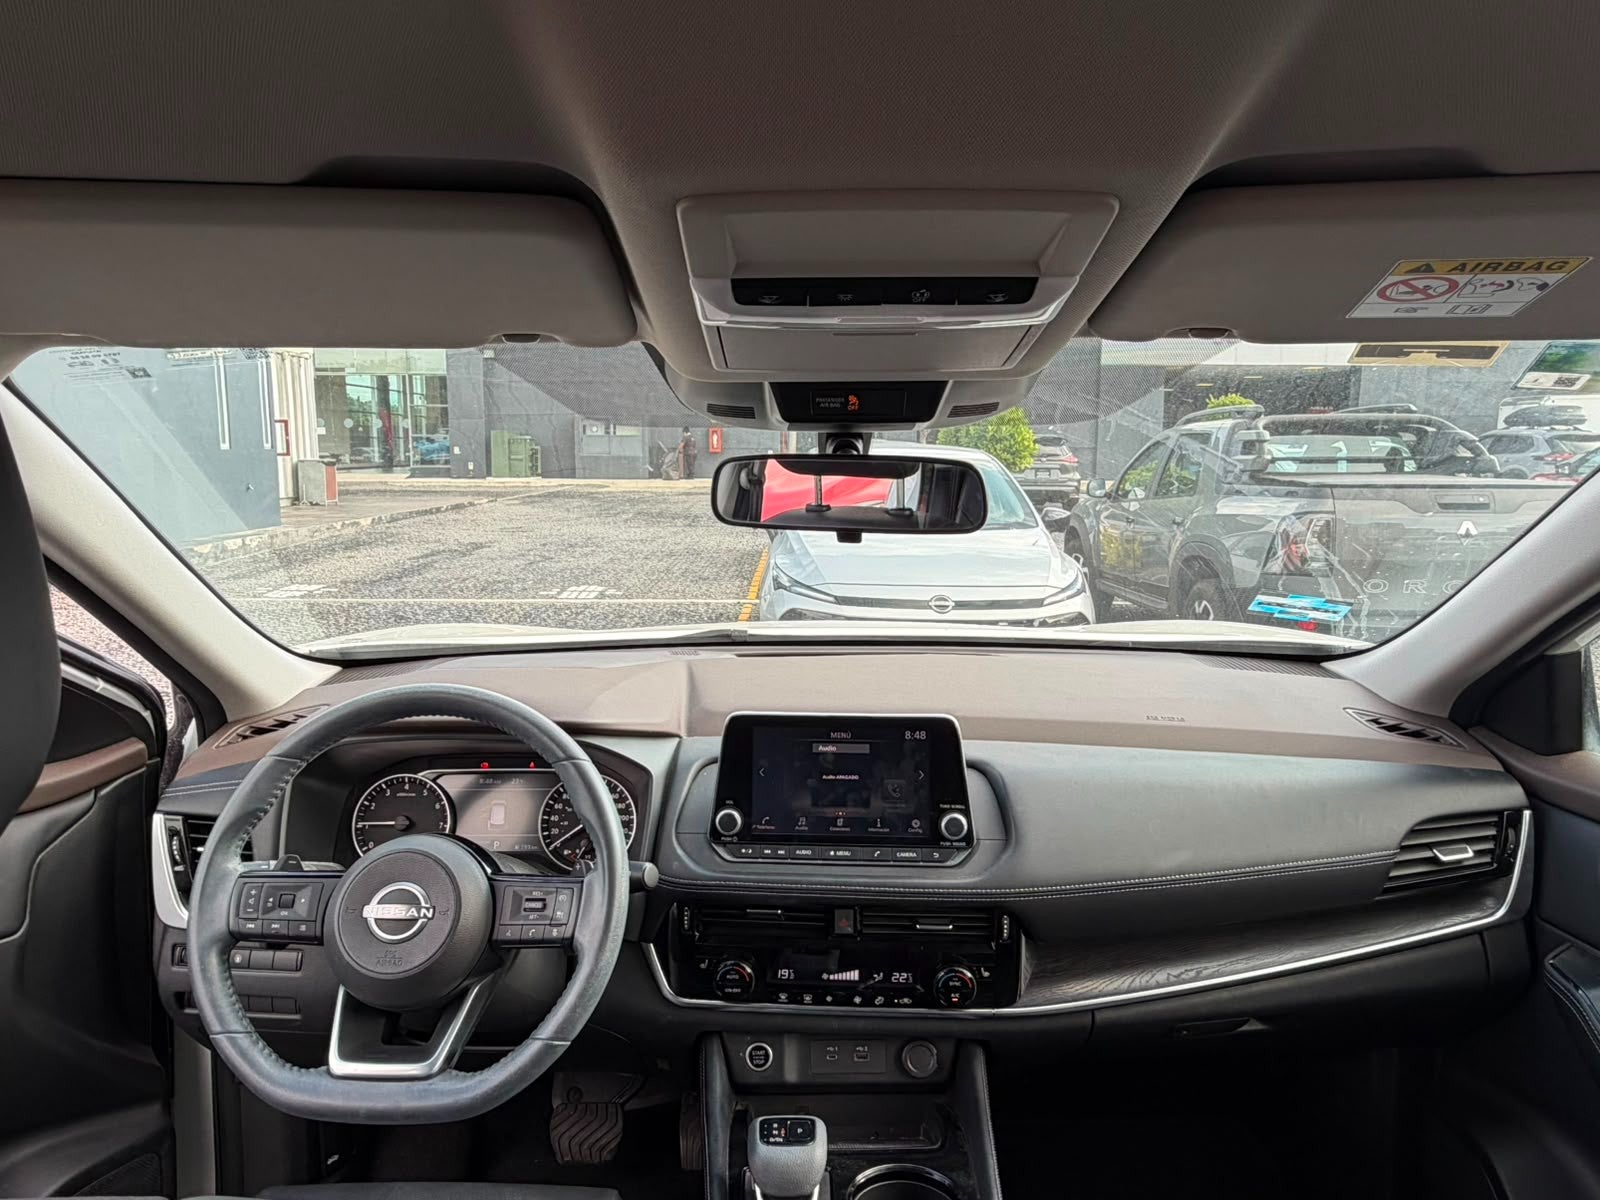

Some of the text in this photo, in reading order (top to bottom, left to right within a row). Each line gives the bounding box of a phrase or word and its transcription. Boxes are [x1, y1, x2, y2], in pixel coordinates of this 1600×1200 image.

[1446, 260, 1571, 273] AIRBAG
[904, 731, 927, 740] 8:48
[818, 744, 837, 752] Audio
[370, 802, 376, 810] 2
[493, 841, 500, 850] P
[365, 906, 433, 918] NISSAN
